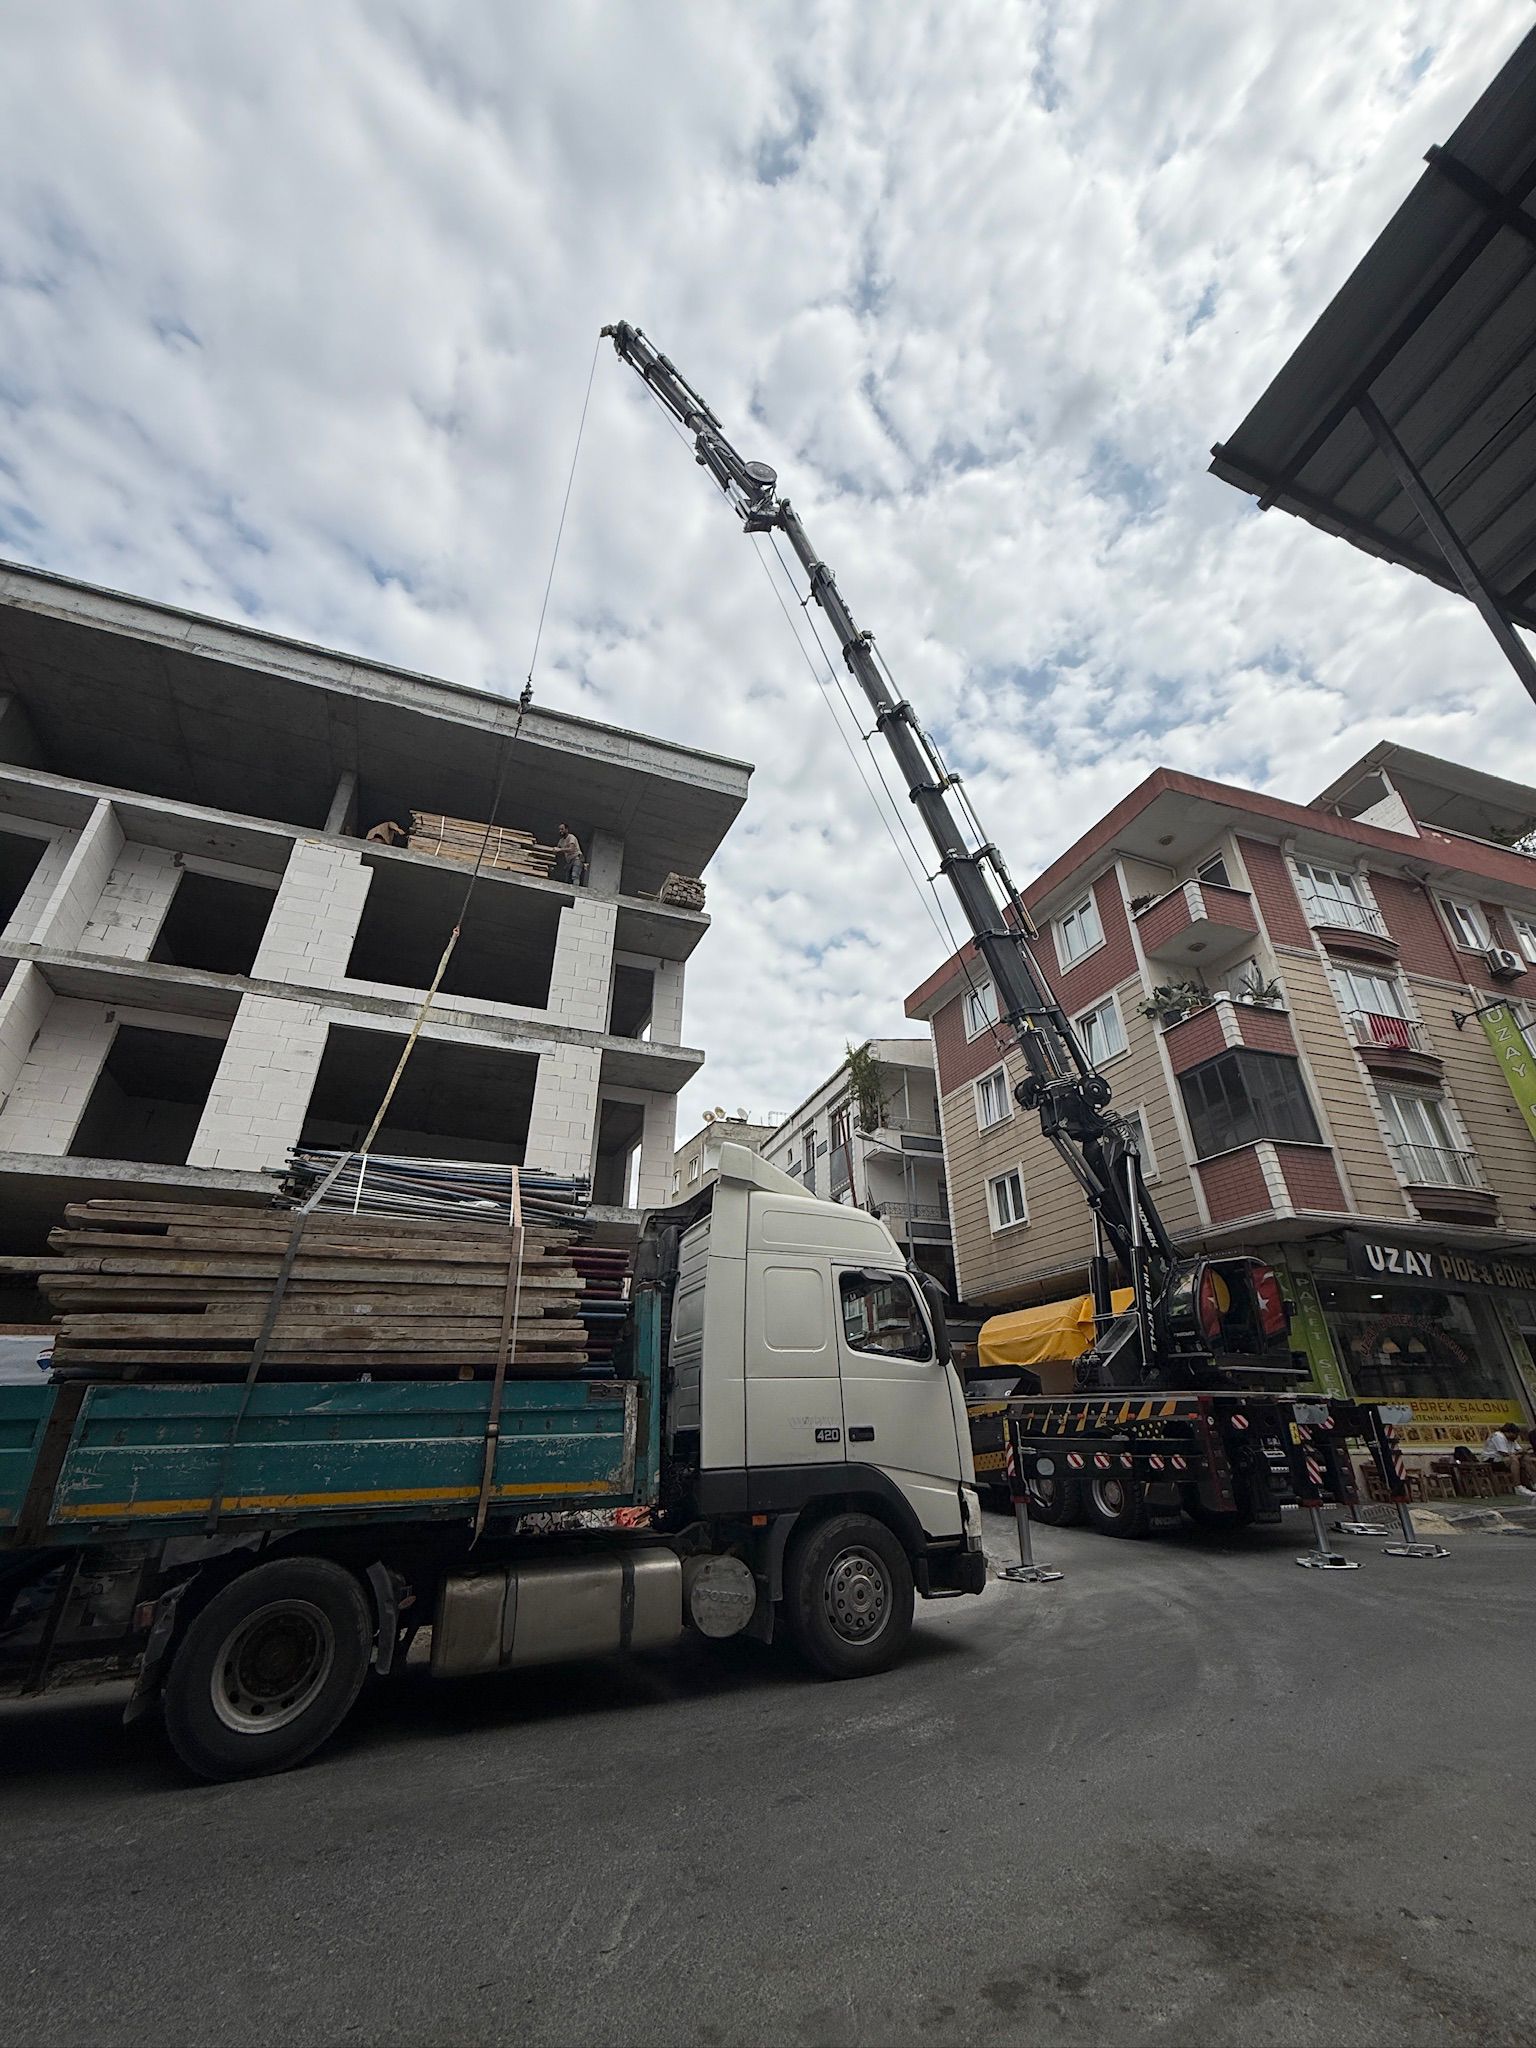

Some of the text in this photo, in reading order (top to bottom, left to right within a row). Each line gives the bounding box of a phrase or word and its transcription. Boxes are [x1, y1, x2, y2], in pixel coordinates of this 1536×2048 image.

[1486, 1006, 1526, 1077] UZAY
[1138, 1203, 1159, 1248] NOMEK
[1365, 1244, 1433, 1278] UZAY
[1296, 1278, 1342, 1399] PAKET SER
[1458, 1402, 1510, 1413] SALONU
[817, 1429, 839, 1441] 420
